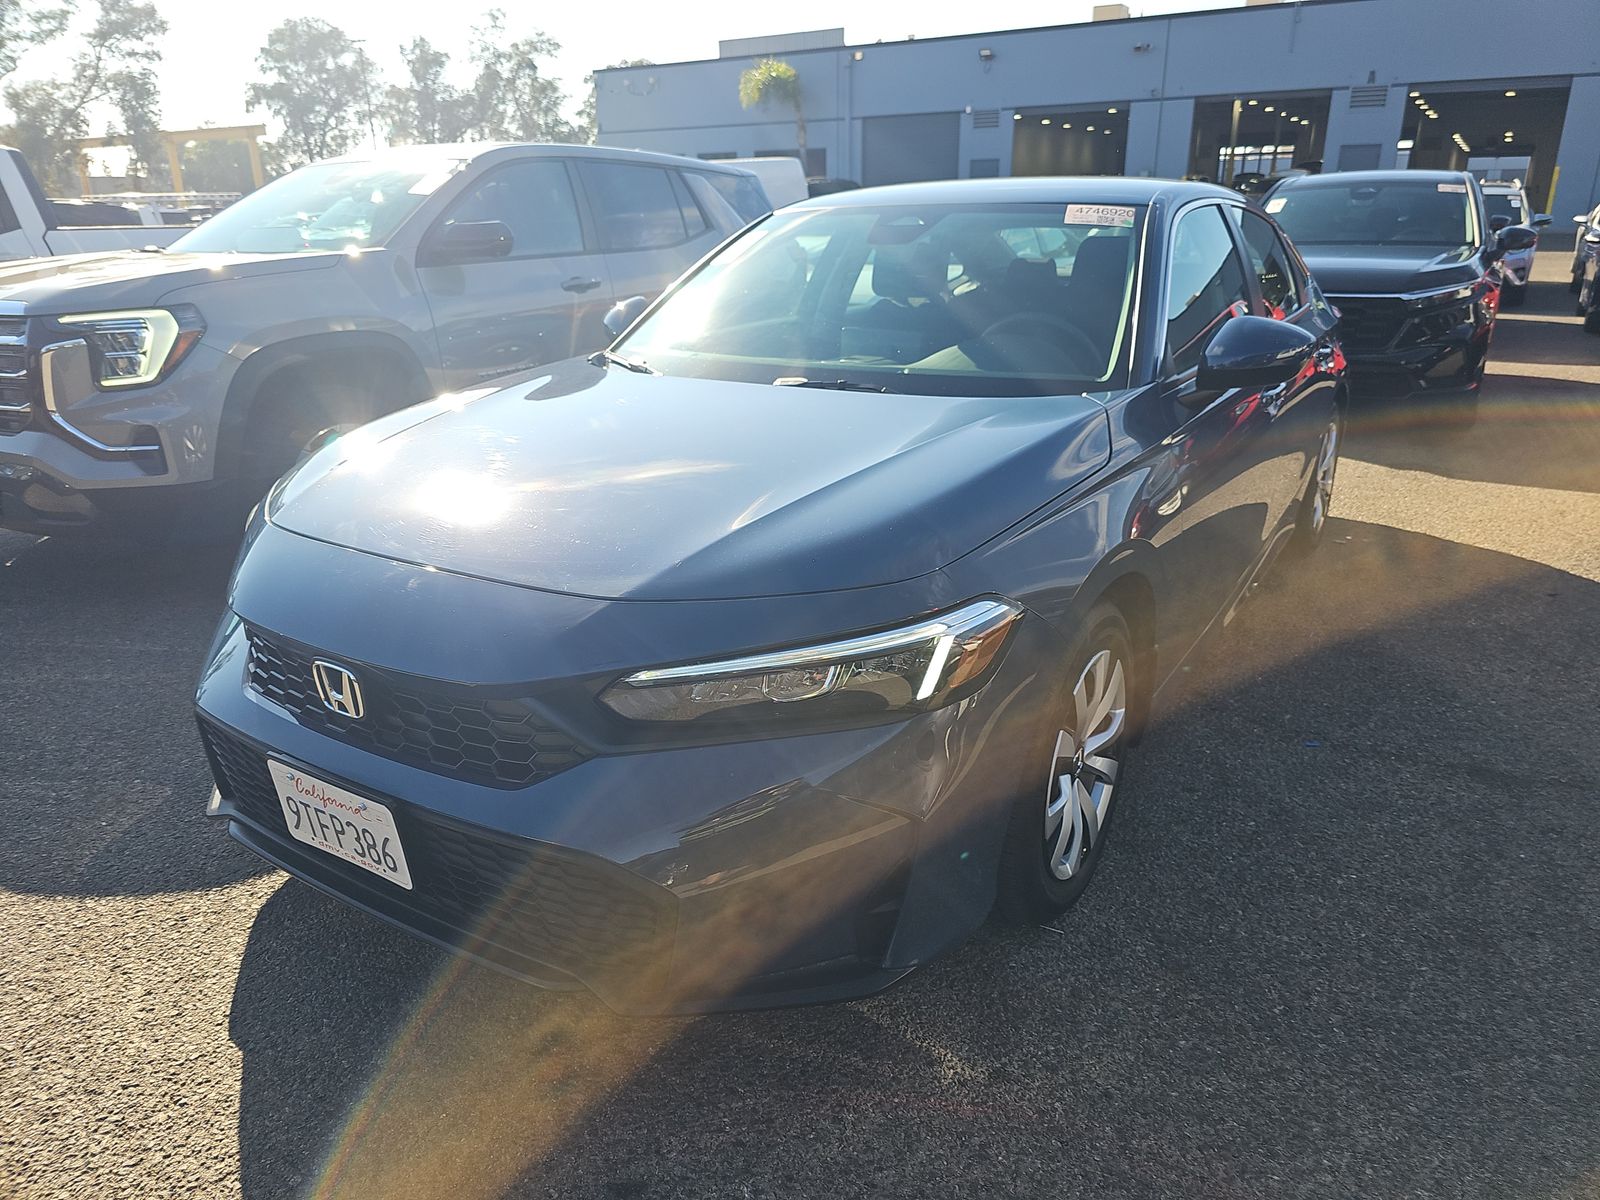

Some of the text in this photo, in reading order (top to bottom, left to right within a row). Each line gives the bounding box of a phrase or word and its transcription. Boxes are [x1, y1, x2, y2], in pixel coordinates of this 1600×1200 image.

[295, 777, 372, 822] California
[286, 796, 398, 873] 9TFP386
[318, 841, 380, 871] dmv.ca.gov
